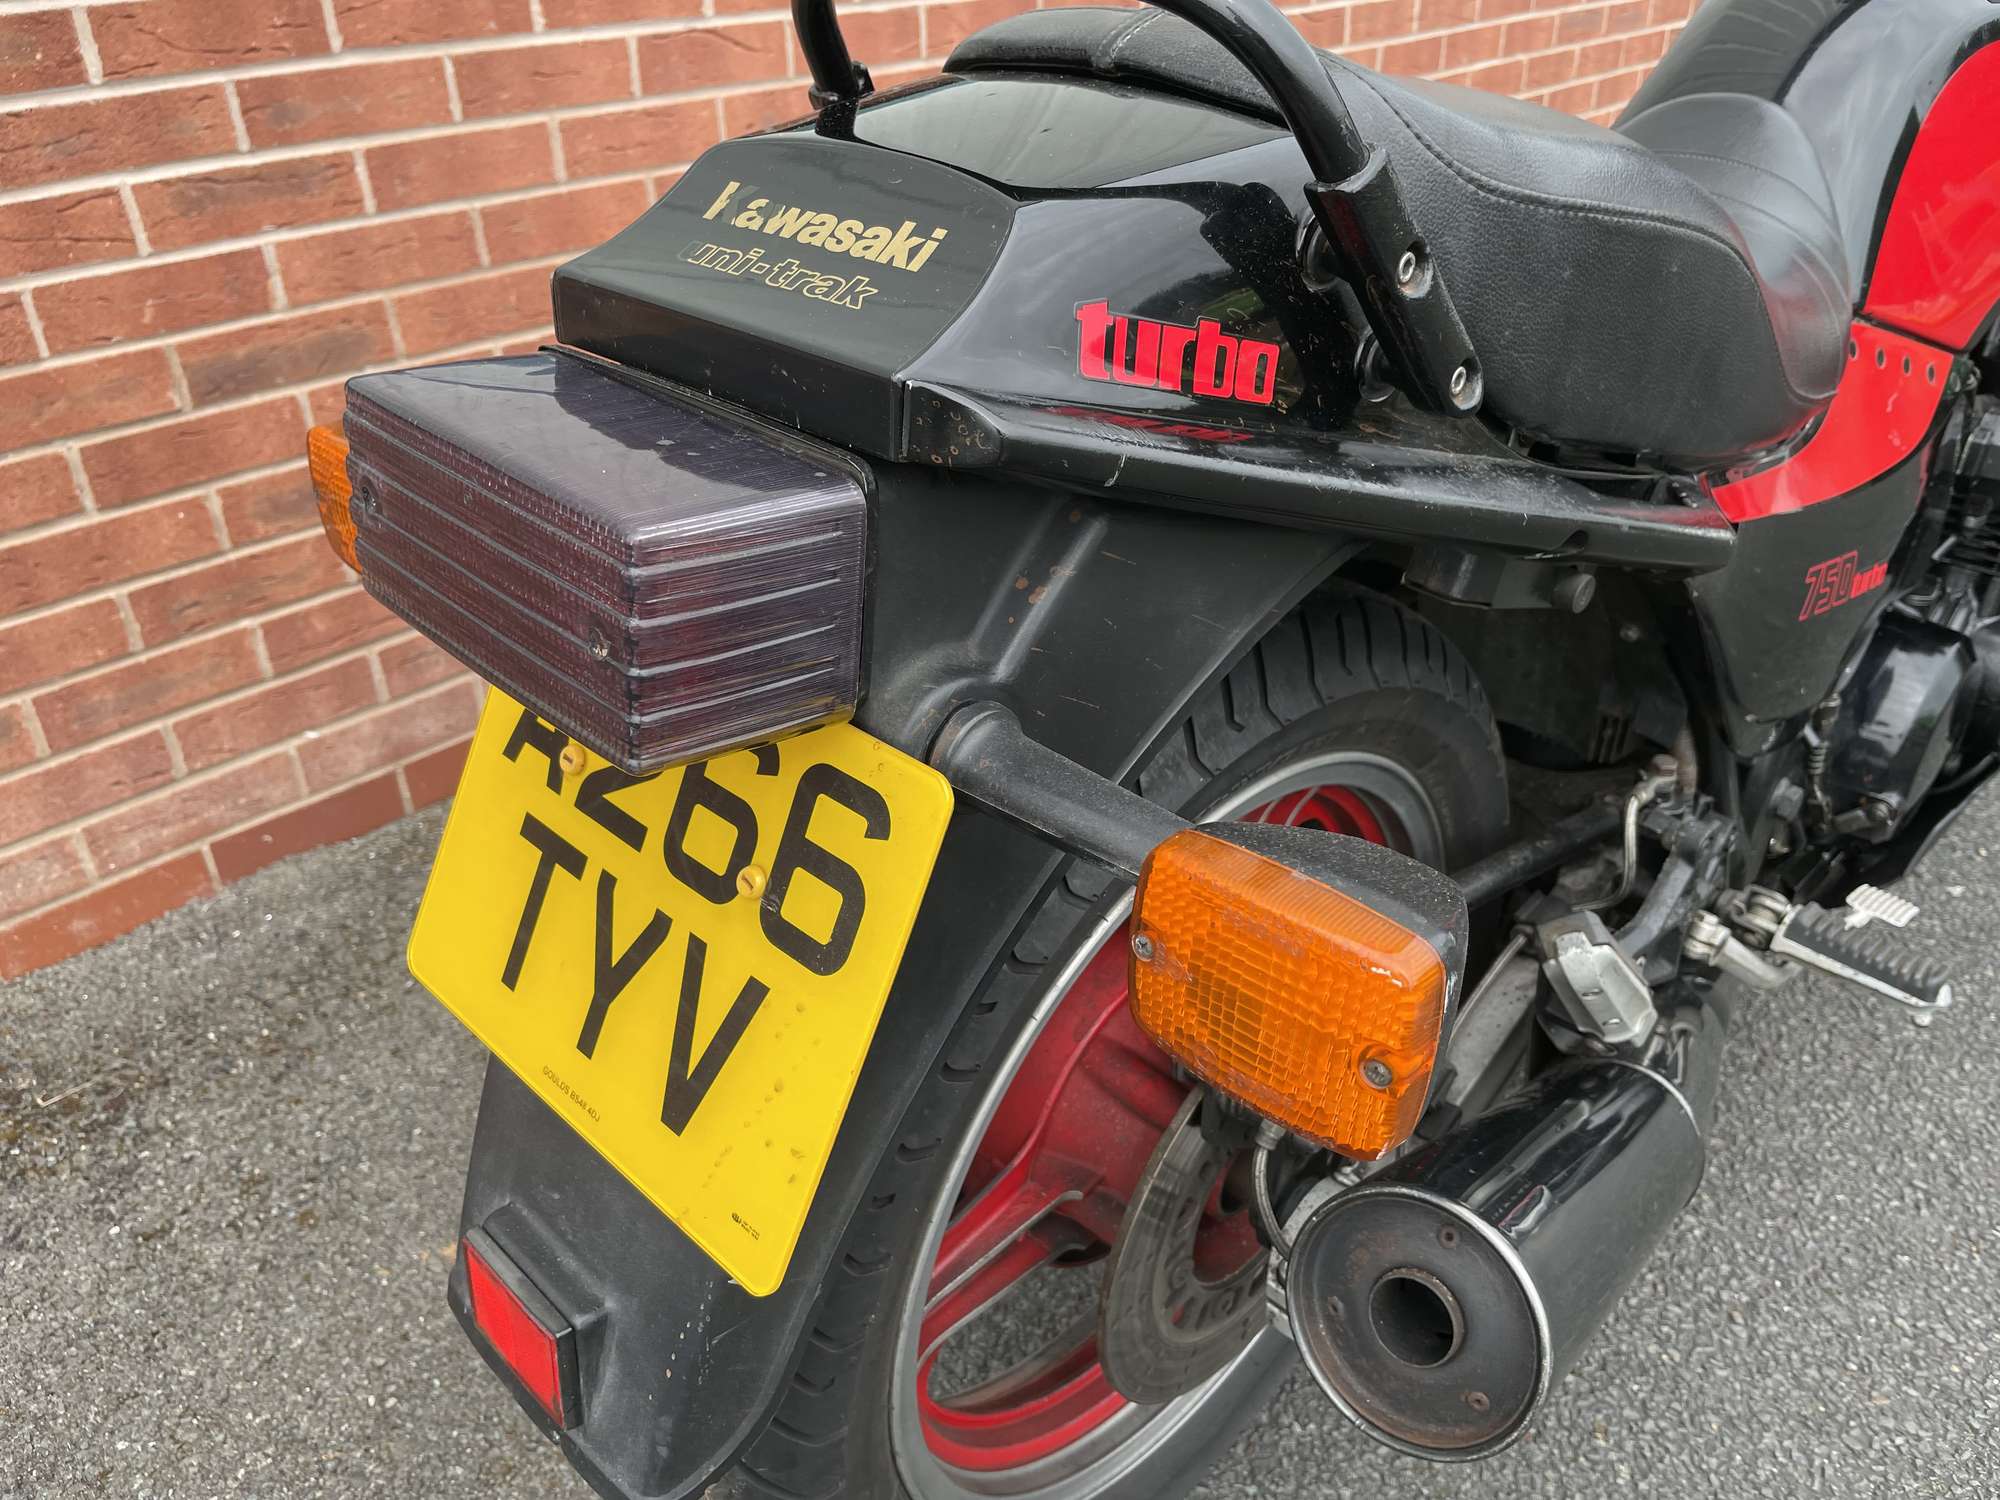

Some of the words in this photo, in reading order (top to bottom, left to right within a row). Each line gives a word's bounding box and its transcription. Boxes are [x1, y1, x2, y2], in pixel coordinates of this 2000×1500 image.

[702, 180, 949, 273] Kawasaki
[679, 240, 879, 310] uni-trak
[1075, 299, 1281, 405] turbo
[1798, 550, 1858, 621] 750
[501, 811, 771, 1137] TYV
